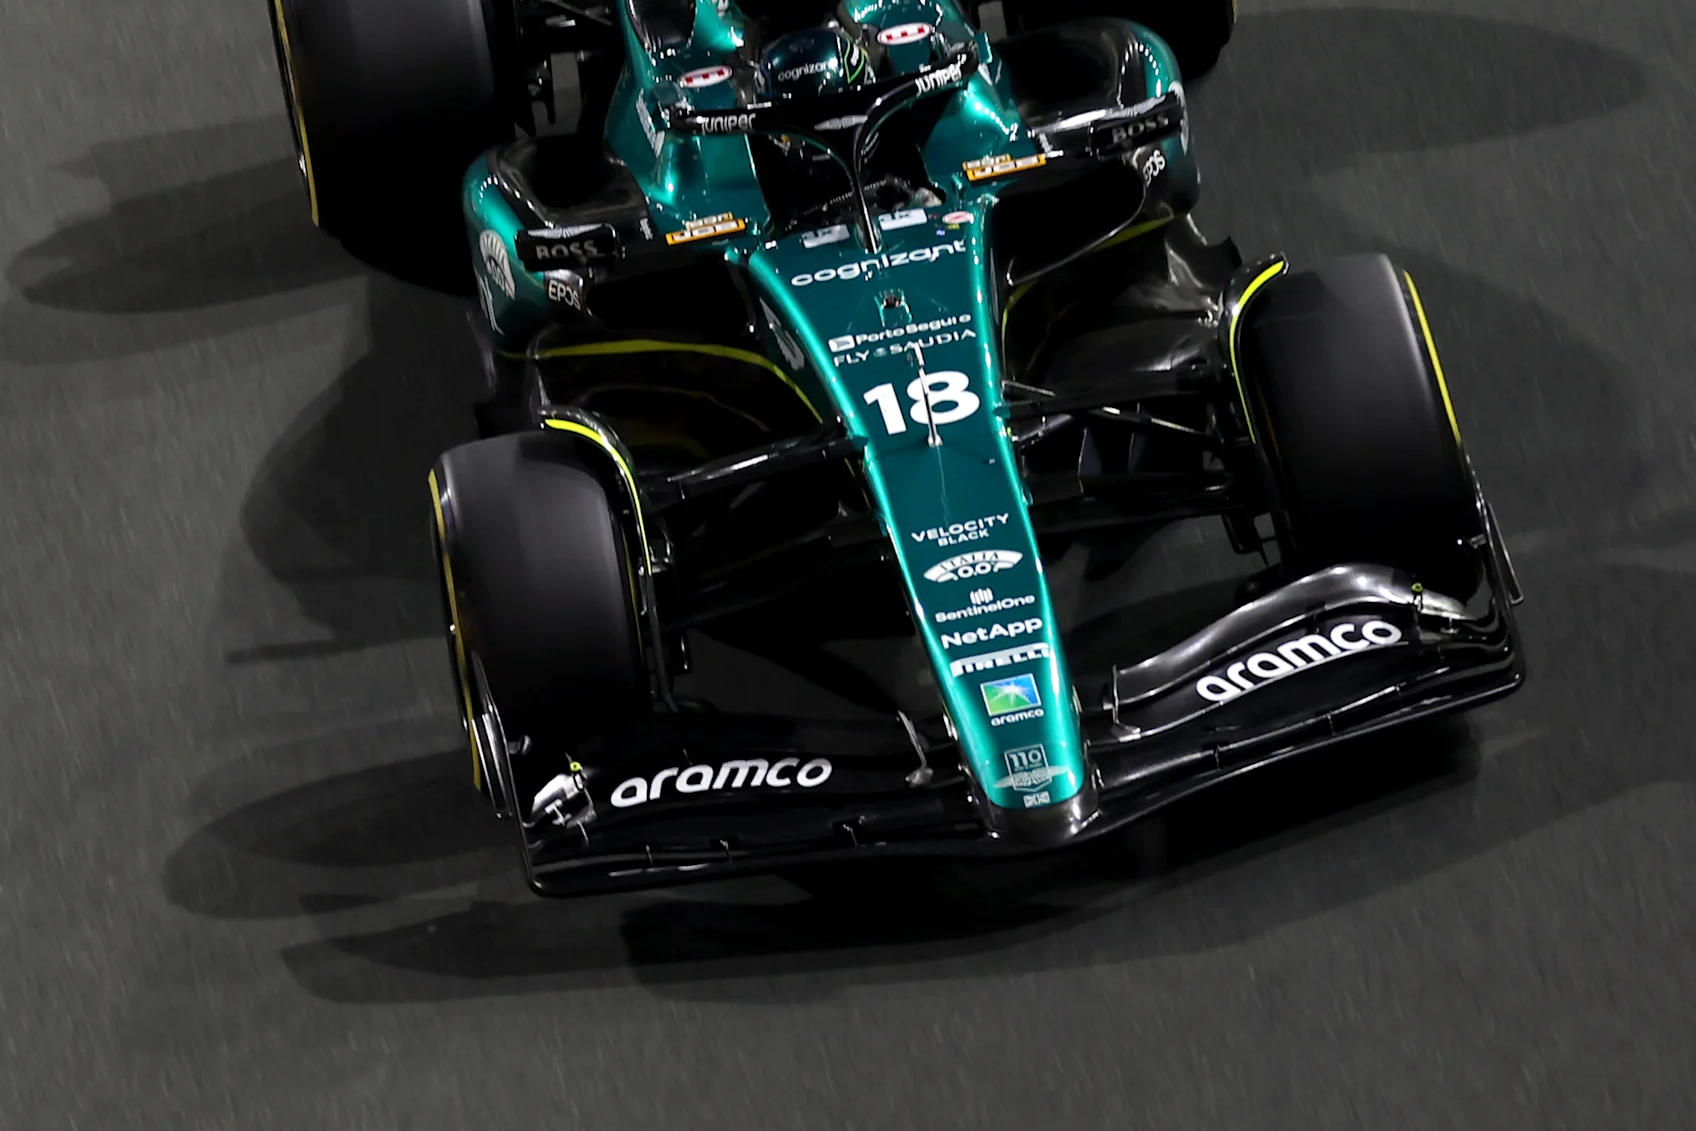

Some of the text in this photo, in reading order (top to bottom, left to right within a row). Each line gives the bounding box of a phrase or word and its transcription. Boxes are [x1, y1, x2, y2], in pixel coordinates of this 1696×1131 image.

[534, 239, 599, 262] BOSS
[790, 238, 967, 287] cognizant
[547, 279, 582, 313] EPOS
[833, 327, 977, 368] FLY SAUDIA
[862, 370, 981, 435] 18
[911, 512, 1010, 543] VELOCITY
[937, 528, 990, 547] BLACK
[934, 594, 1036, 623] SentinelOne
[940, 617, 1044, 650] NetApp
[949, 641, 1051, 679] PIRELLI
[1195, 619, 1403, 703] aramco
[990, 708, 1045, 727] aramco
[1008, 749, 1043, 768] 110
[610, 757, 833, 808] aramco
